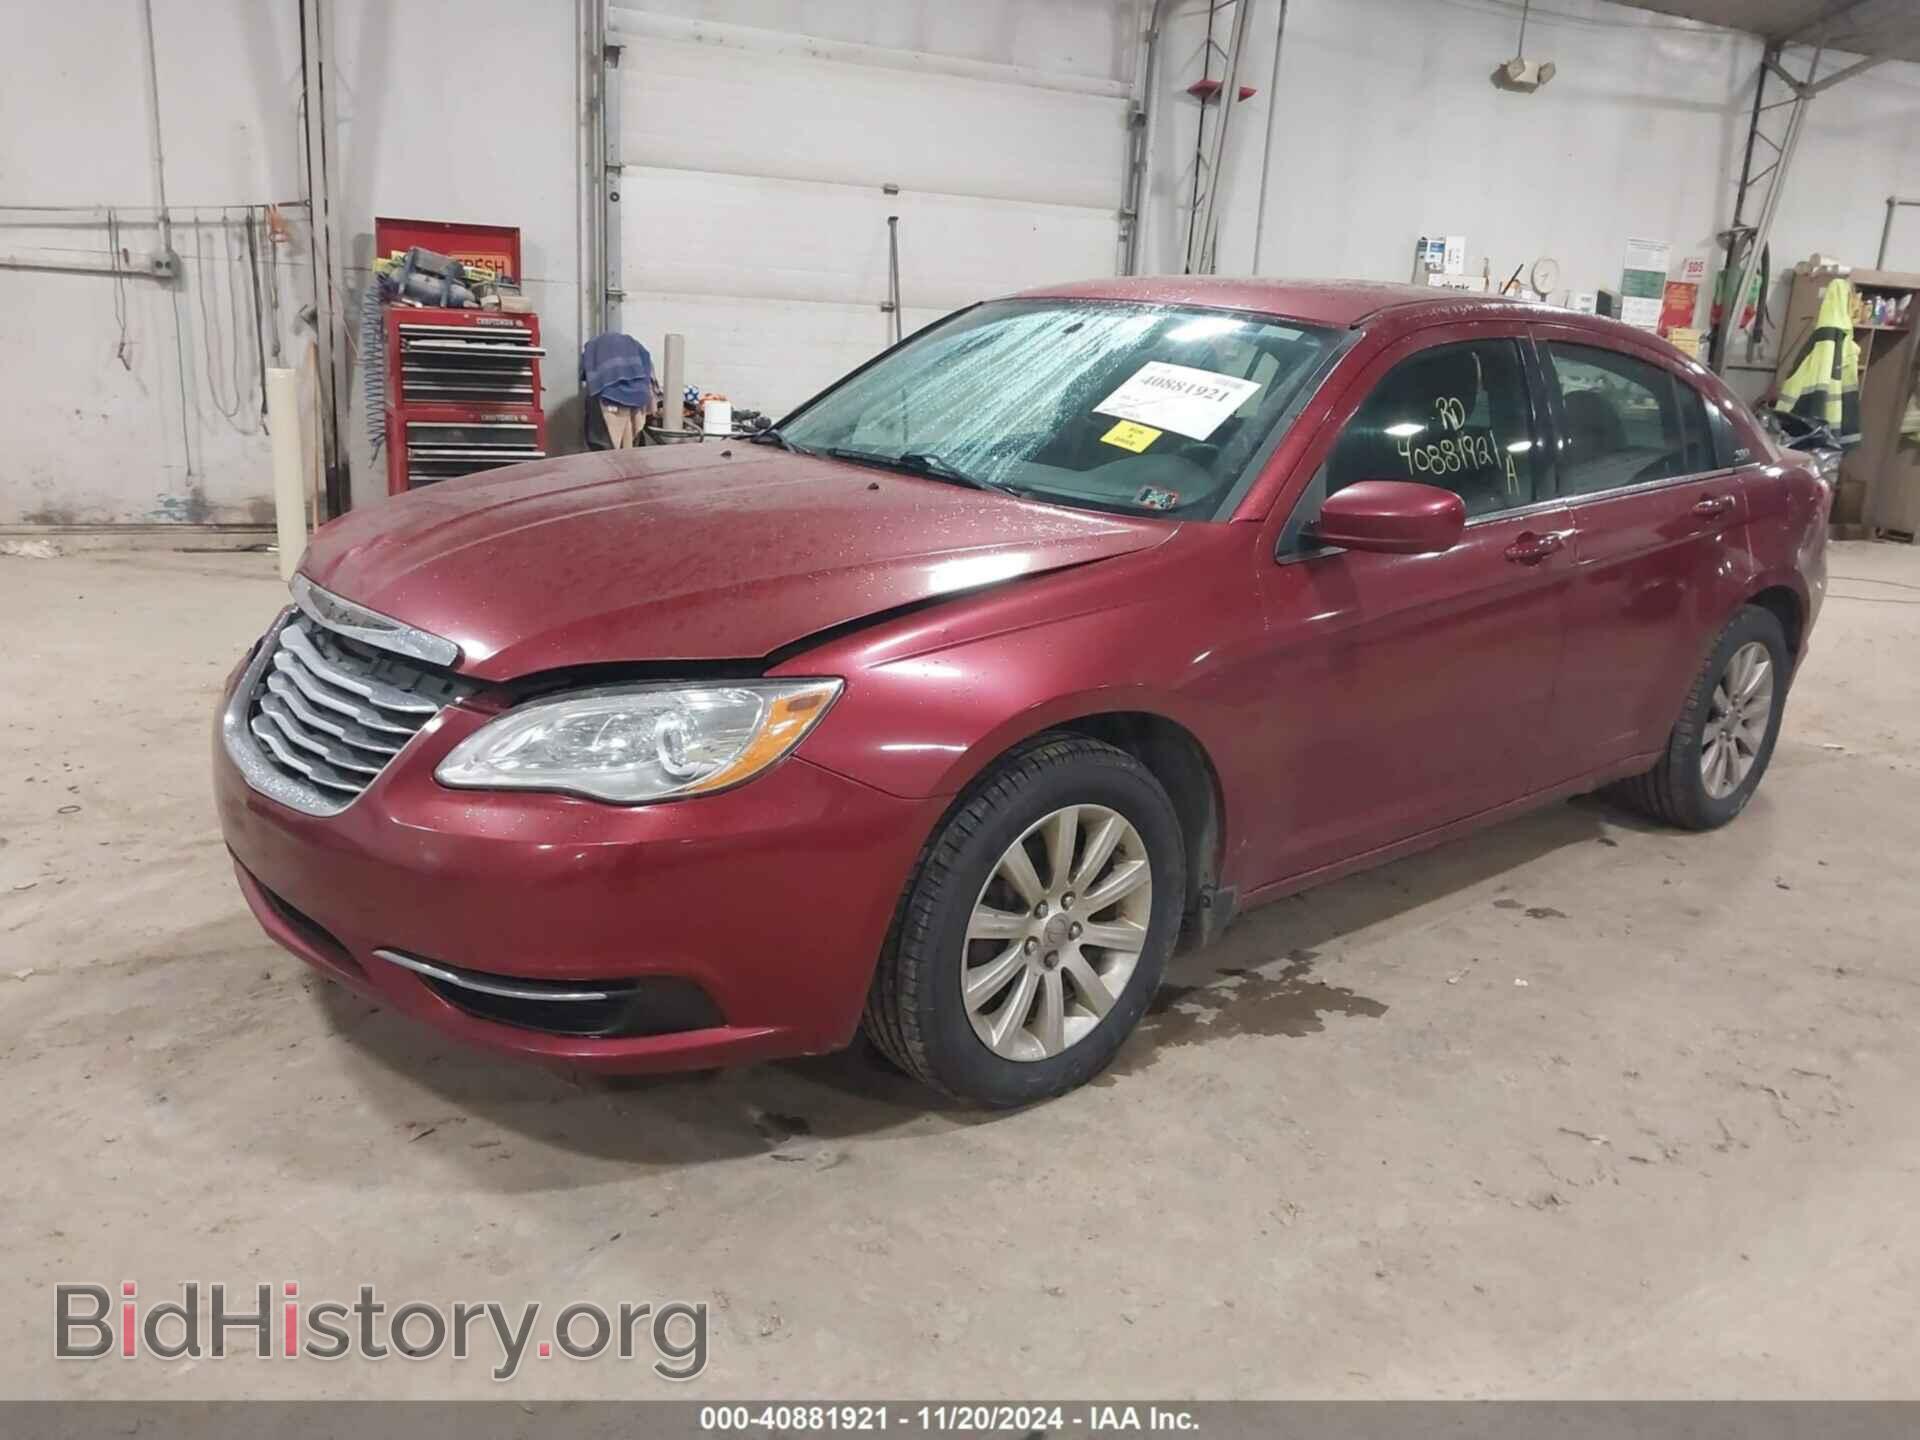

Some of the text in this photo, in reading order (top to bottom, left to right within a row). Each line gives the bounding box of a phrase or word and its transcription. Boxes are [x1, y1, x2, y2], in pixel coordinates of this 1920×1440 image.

[456, 258, 505, 273] RESH
[1142, 375, 1230, 402] 40881921
[1397, 429, 1503, 476] 40881921
[1505, 453, 1520, 496] A
